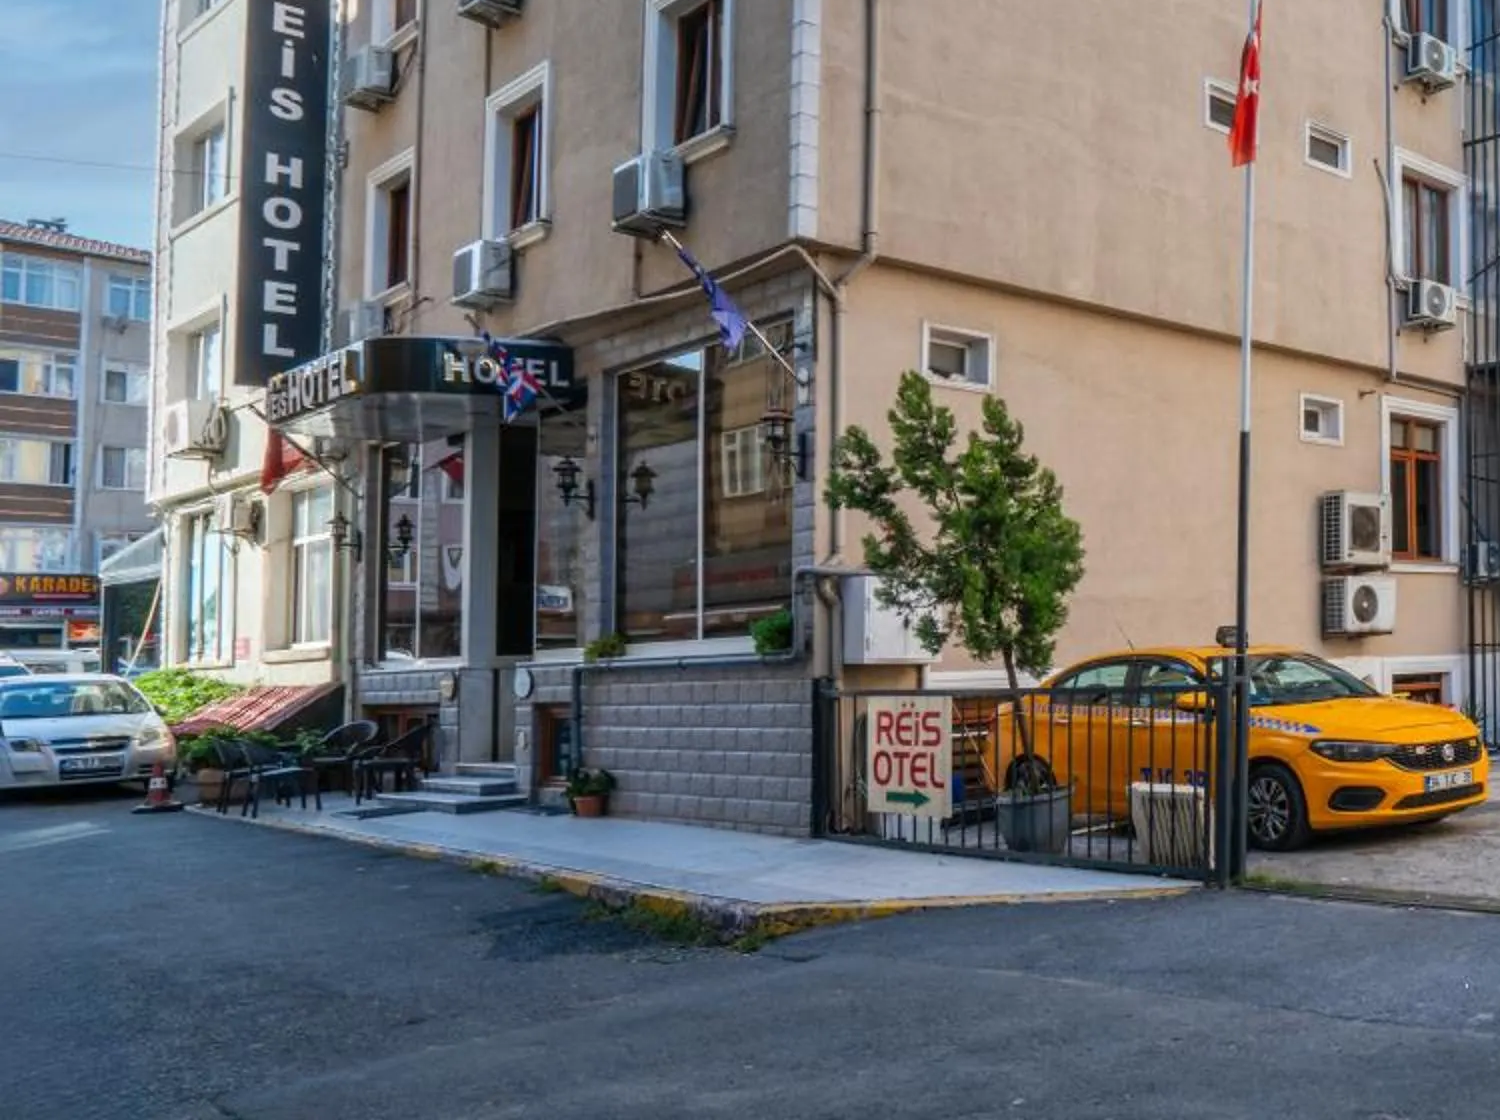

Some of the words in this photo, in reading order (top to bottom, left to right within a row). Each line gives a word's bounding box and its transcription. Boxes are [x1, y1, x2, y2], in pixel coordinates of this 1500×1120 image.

[262, 151, 304, 358] HOTEL
[288, 349, 357, 415] HOTEL
[15, 575, 97, 593] KARADE
[874, 750, 945, 789] OTEL
